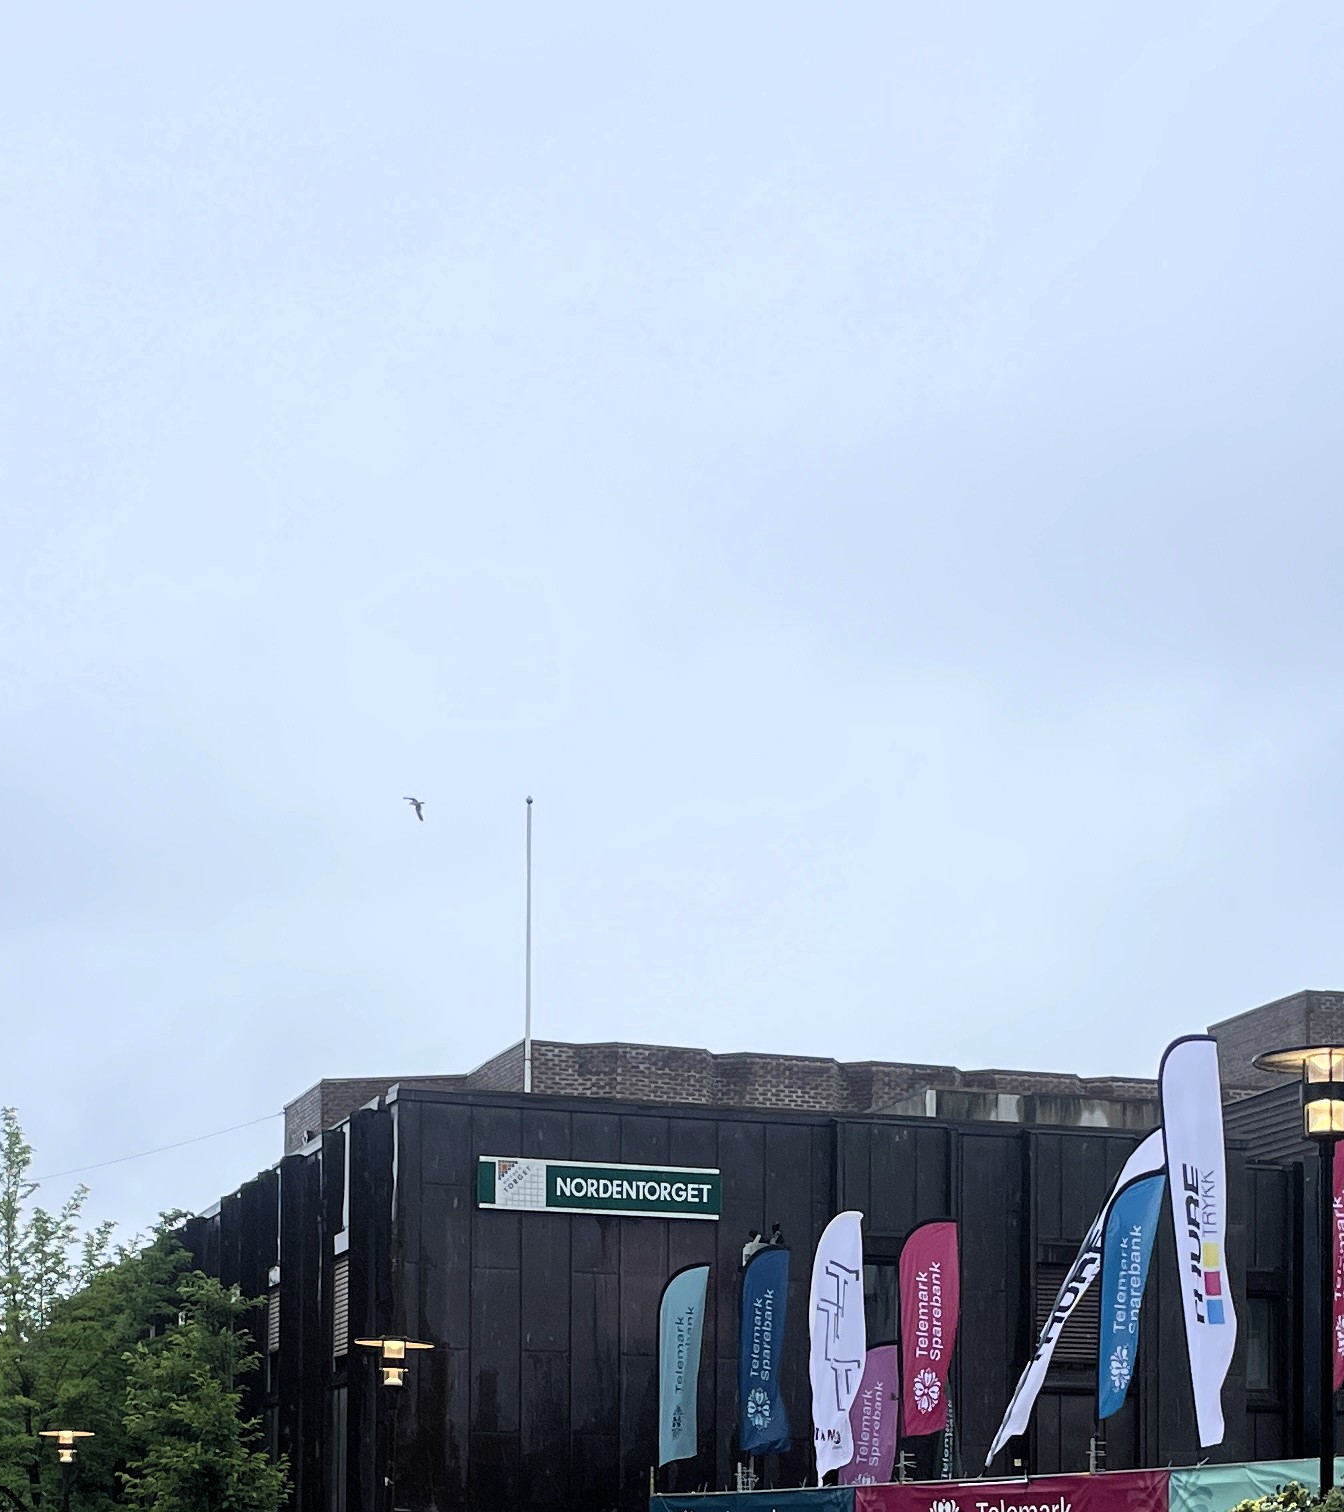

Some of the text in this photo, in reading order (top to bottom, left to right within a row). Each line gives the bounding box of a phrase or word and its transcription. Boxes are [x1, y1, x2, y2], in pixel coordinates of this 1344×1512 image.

[556, 1177, 712, 1203] NORDENTORGET
[1201, 1169, 1218, 1237] TRYKK
[750, 1297, 763, 1378] Telemark
[760, 1288, 775, 1381] Sparebank
[916, 1271, 929, 1358] Telemark
[929, 1261, 944, 1361] Sparebank
[675, 1316, 685, 1394] Telemark
[856, 1389, 873, 1464] Telemark
[868, 1381, 884, 1466] Sparebank
